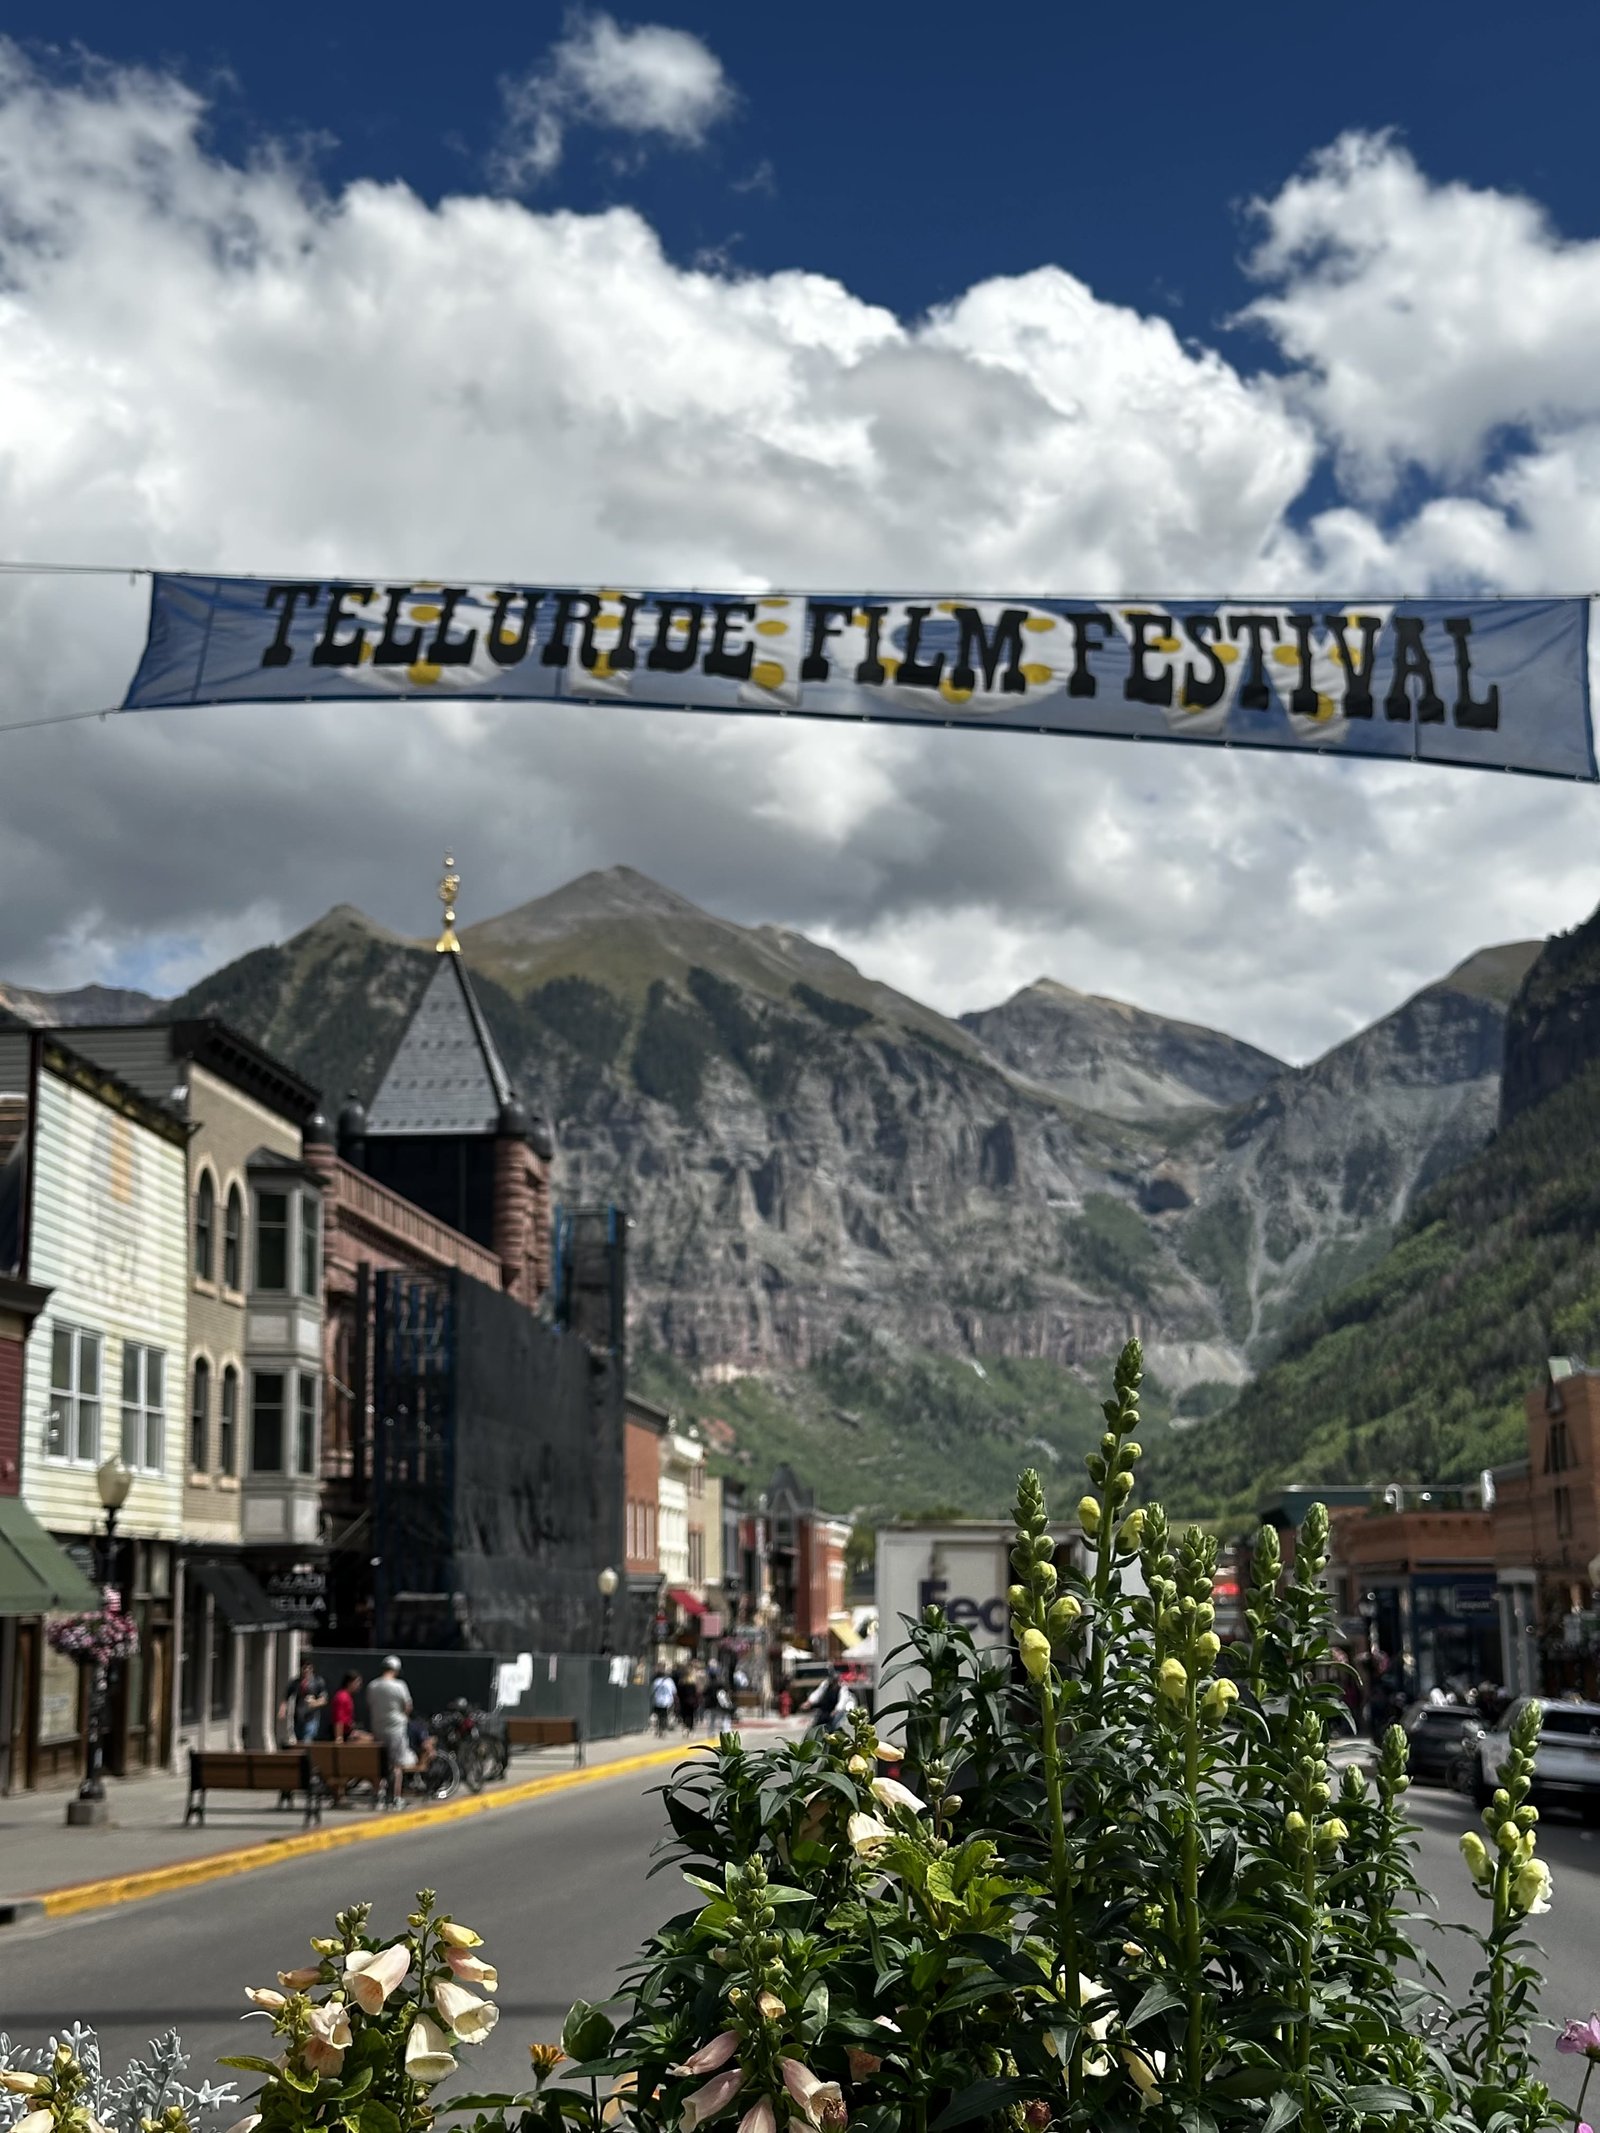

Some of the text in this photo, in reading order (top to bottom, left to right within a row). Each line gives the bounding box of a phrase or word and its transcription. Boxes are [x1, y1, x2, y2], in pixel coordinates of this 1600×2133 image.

[262, 585, 1500, 731] TELLURIDE FILM FESTIVAL
